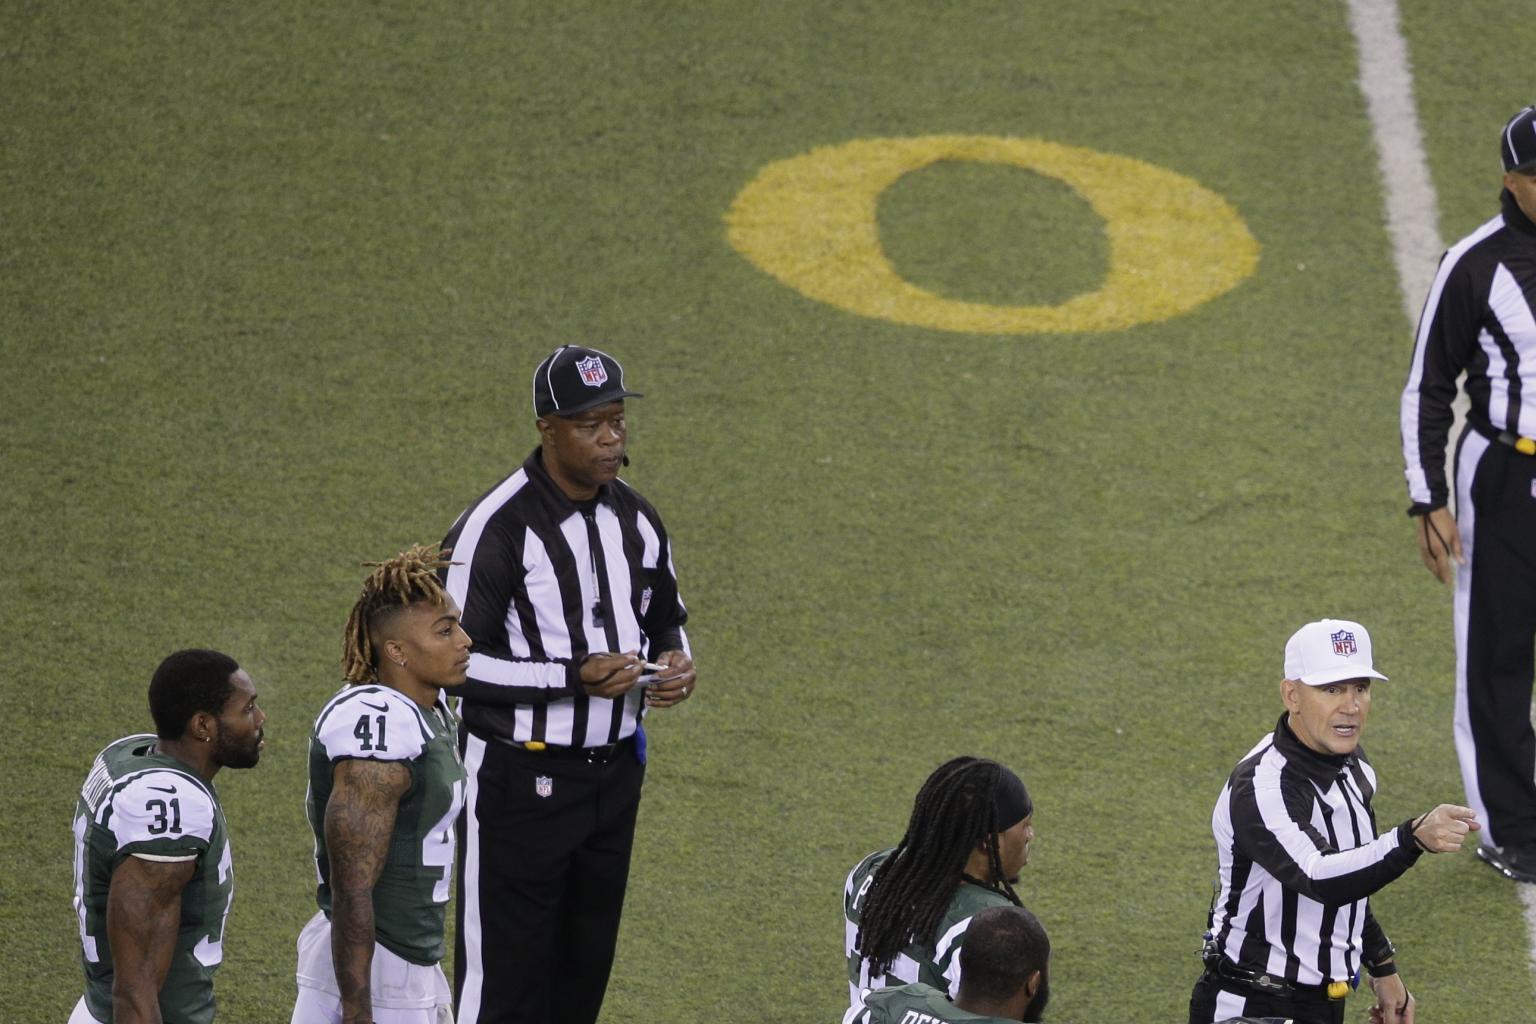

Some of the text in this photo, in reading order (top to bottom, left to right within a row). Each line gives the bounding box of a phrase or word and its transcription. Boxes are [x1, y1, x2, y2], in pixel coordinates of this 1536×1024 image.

[583, 369, 606, 382] NFL
[1335, 641, 1357, 654] NFL
[353, 714, 388, 752] 41
[145, 797, 182, 835] 31
[422, 779, 466, 903] 4
